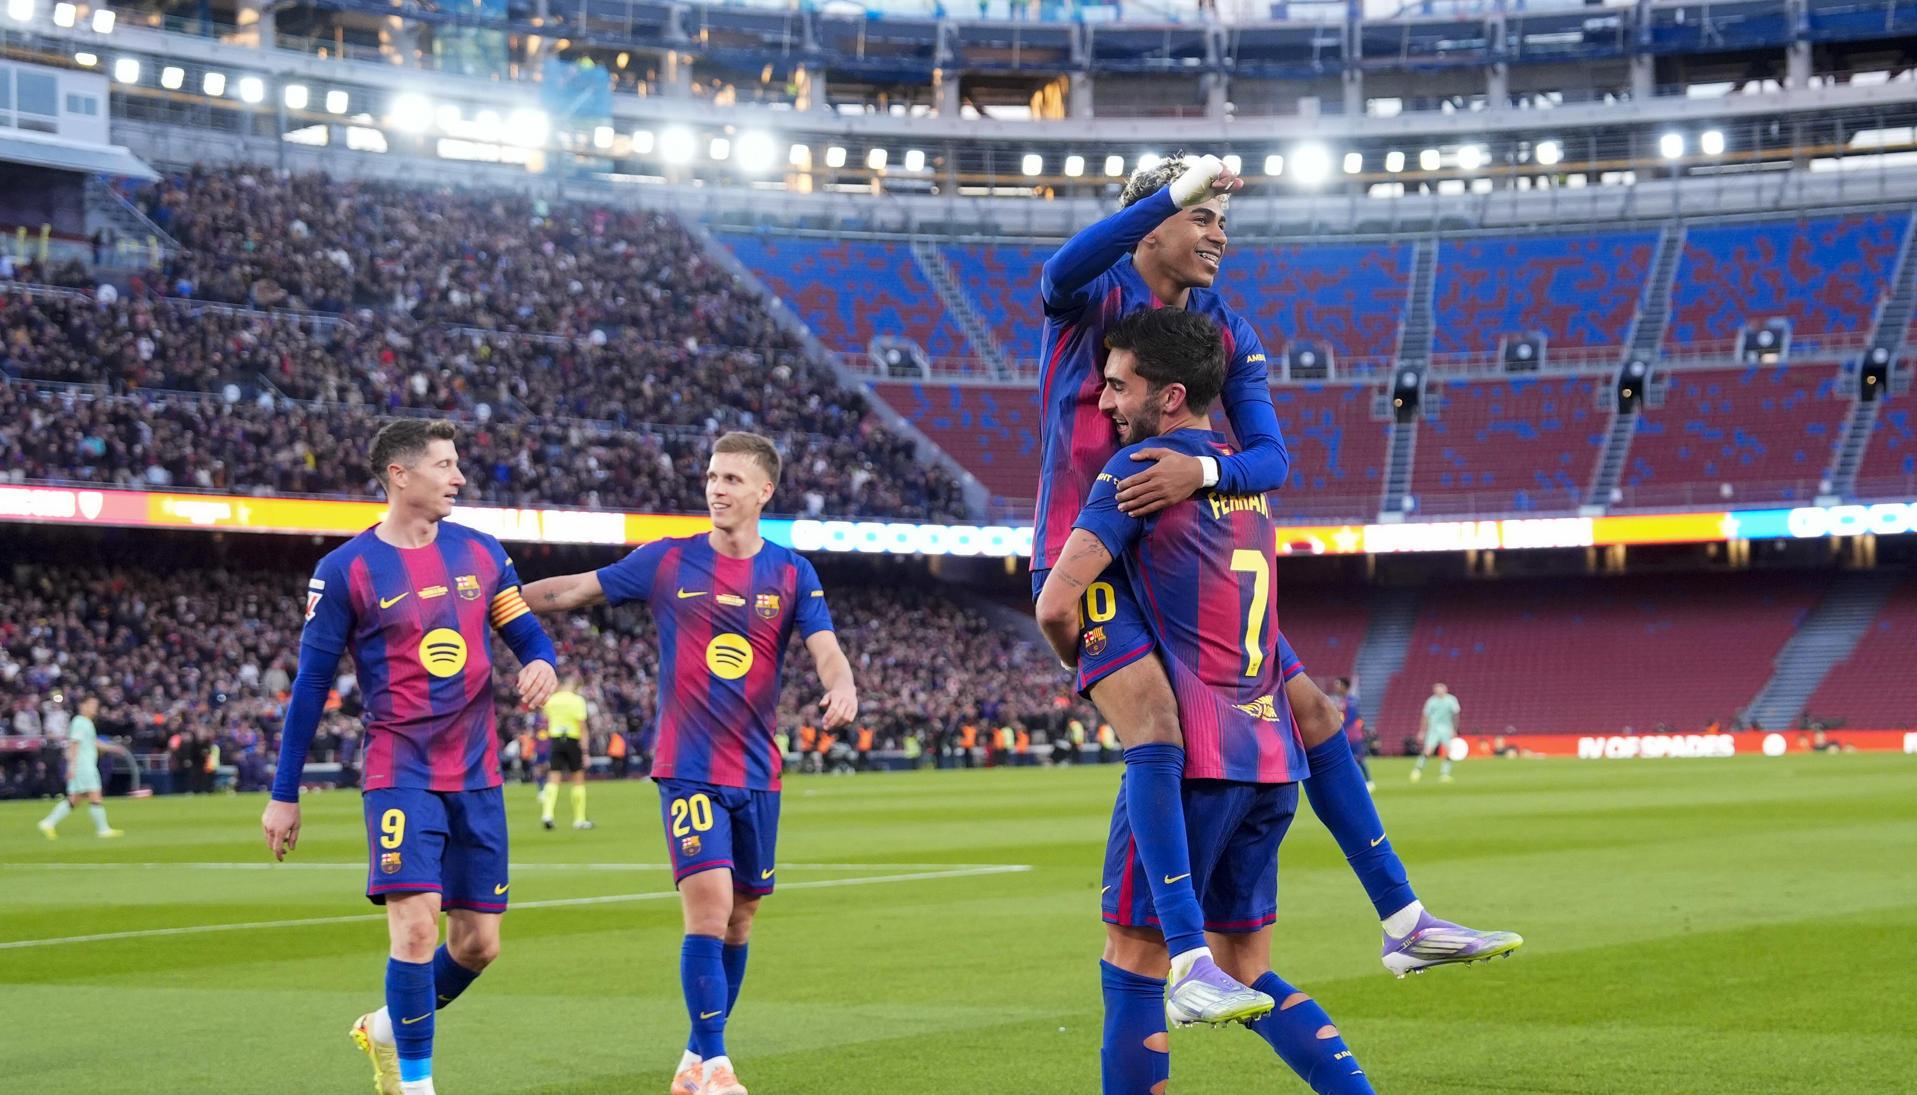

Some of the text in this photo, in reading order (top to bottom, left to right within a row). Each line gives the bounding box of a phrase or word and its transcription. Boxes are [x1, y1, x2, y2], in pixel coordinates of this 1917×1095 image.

[1078, 581, 1116, 629] 0
[1230, 549, 1269, 676] 7
[380, 808, 406, 849] 9
[671, 793, 713, 837] 20
